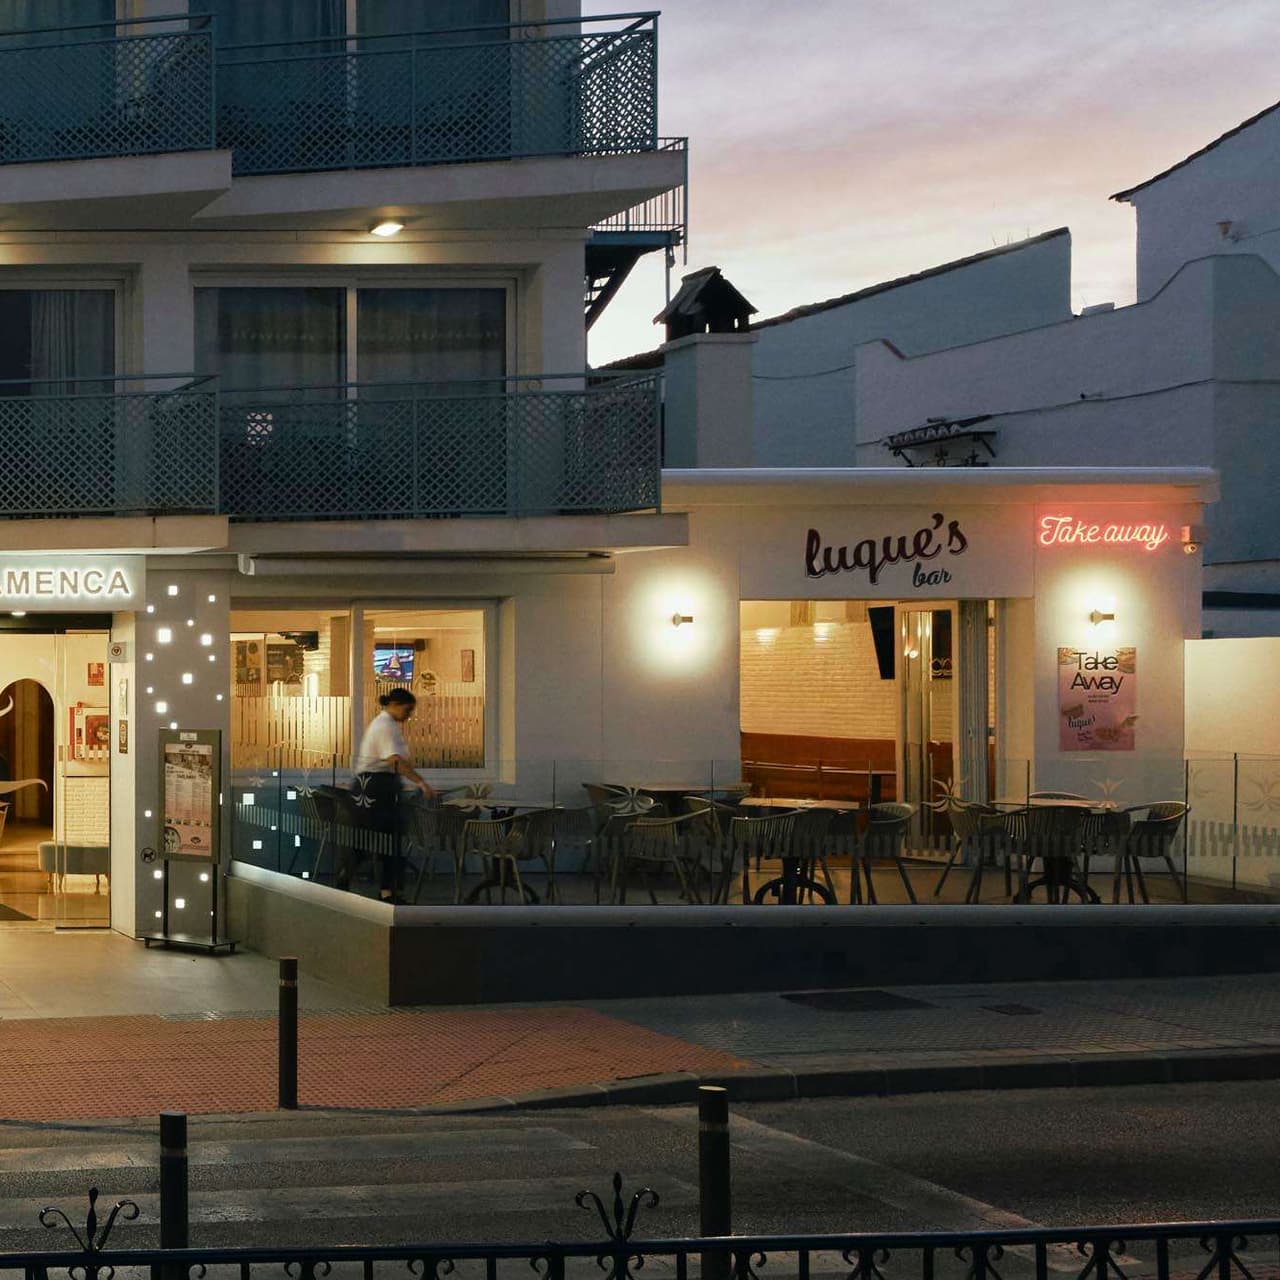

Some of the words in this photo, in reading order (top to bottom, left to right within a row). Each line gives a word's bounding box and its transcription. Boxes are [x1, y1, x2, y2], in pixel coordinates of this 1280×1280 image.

[1040, 516, 1101, 545] Take
[1103, 524, 1168, 550] away
[805, 513, 968, 585] luque's
[912, 562, 952, 587] bar
[1072, 651, 1119, 670] Take
[1070, 671, 1124, 695] Away
